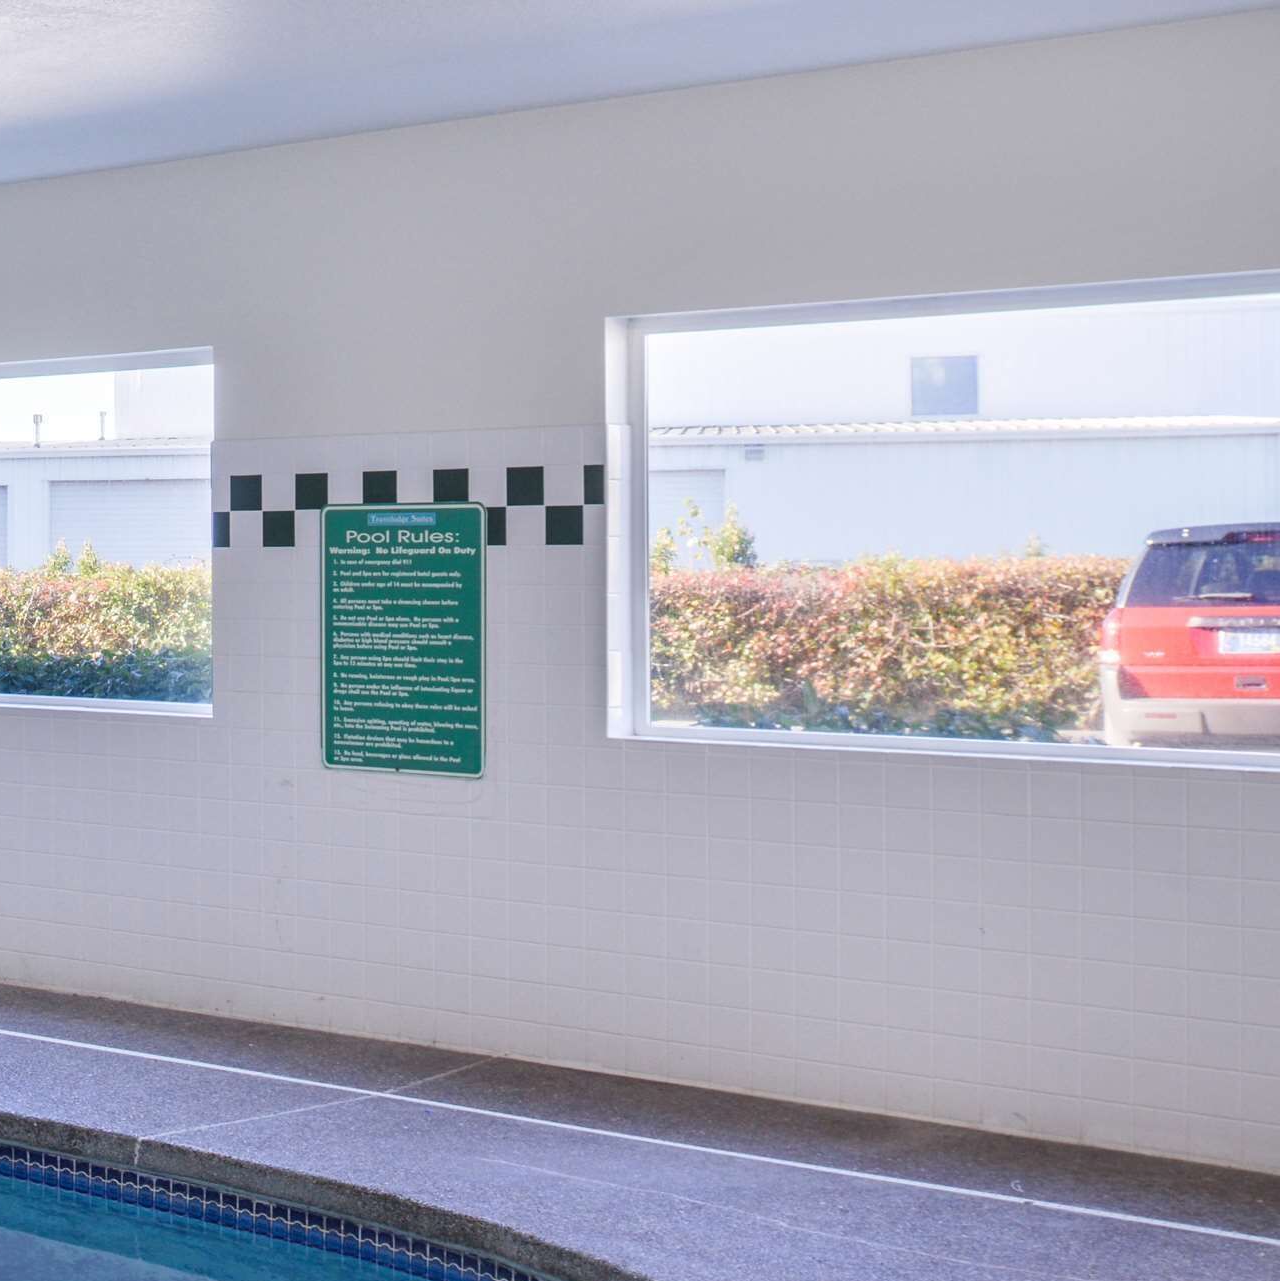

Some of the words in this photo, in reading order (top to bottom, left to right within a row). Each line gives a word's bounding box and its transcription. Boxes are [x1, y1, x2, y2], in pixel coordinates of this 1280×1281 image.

[346, 530, 390, 543] Pool
[398, 530, 460, 543] Rules:
[329, 547, 371, 556] Warning:
[391, 547, 436, 556] Lifeguard
[454, 547, 476, 556] Duty
